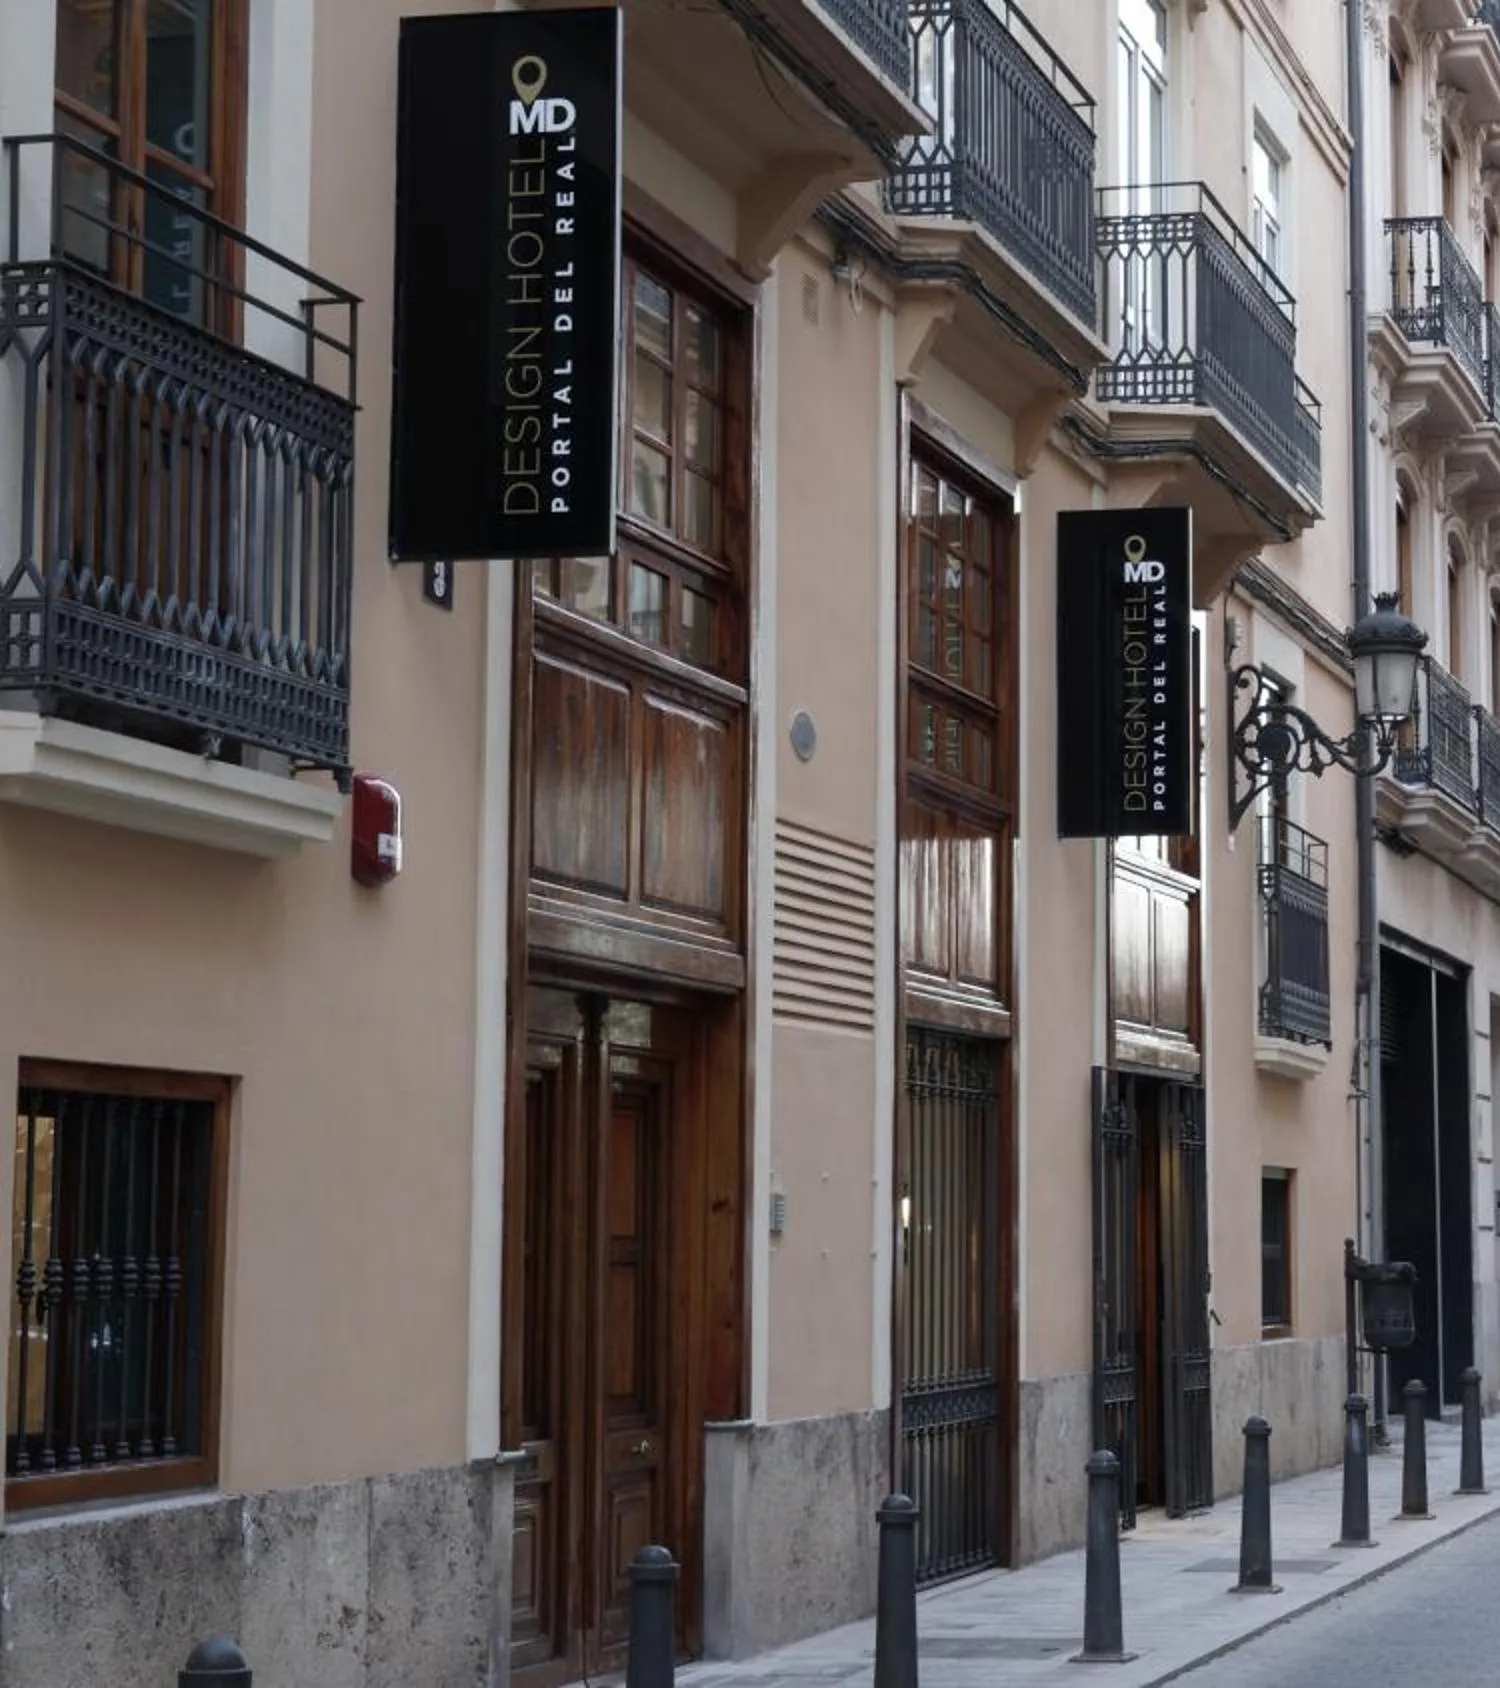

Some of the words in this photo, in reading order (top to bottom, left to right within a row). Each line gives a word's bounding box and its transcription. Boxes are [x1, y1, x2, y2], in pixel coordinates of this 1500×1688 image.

[510, 98, 577, 136] MD
[506, 138, 546, 304] HOTEL
[555, 136, 576, 235] REAL
[553, 261, 574, 332] DEL
[503, 327, 543, 515] DESIGN
[551, 359, 573, 513] PORTAL
[1123, 560, 1165, 583] MD
[1153, 585, 1167, 645] REAL
[1123, 585, 1147, 687] HOTEL
[1153, 660, 1167, 704] DEL
[1123, 697, 1147, 811] DESIGN
[1153, 720, 1167, 811] PORTAL
